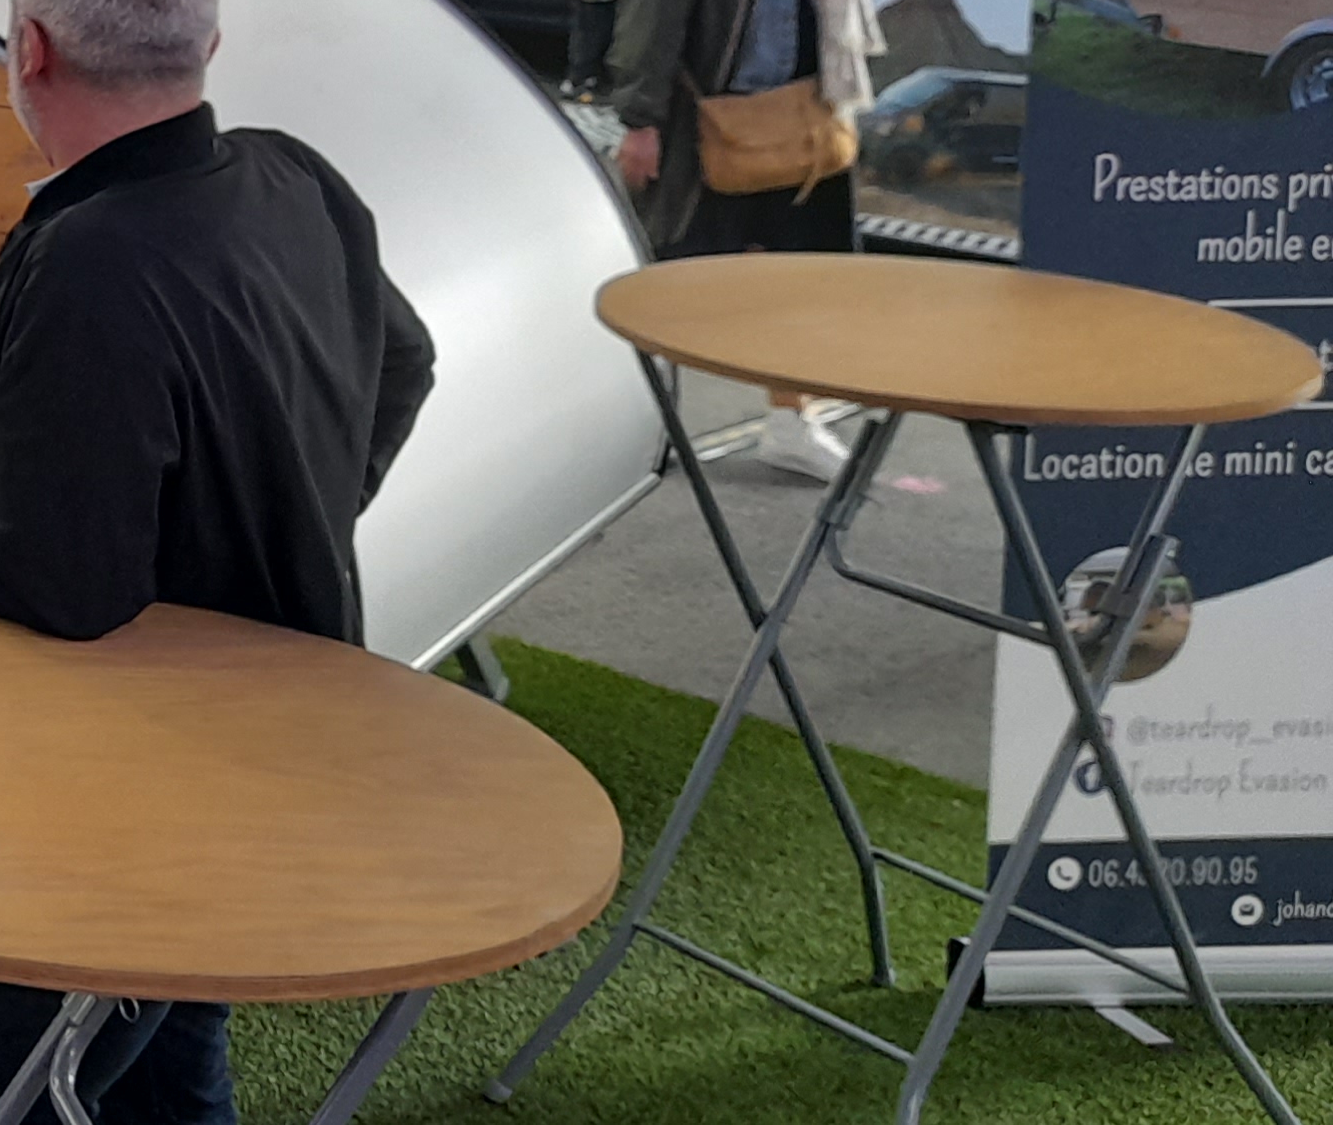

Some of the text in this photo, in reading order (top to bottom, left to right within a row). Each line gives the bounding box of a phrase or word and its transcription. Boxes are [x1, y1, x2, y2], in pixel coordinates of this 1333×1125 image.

[1093, 152, 1333, 213] Prestations pri
[1197, 208, 1303, 262] mobile
[1023, 433, 1164, 482] Location
[1224, 441, 1295, 476] mini
